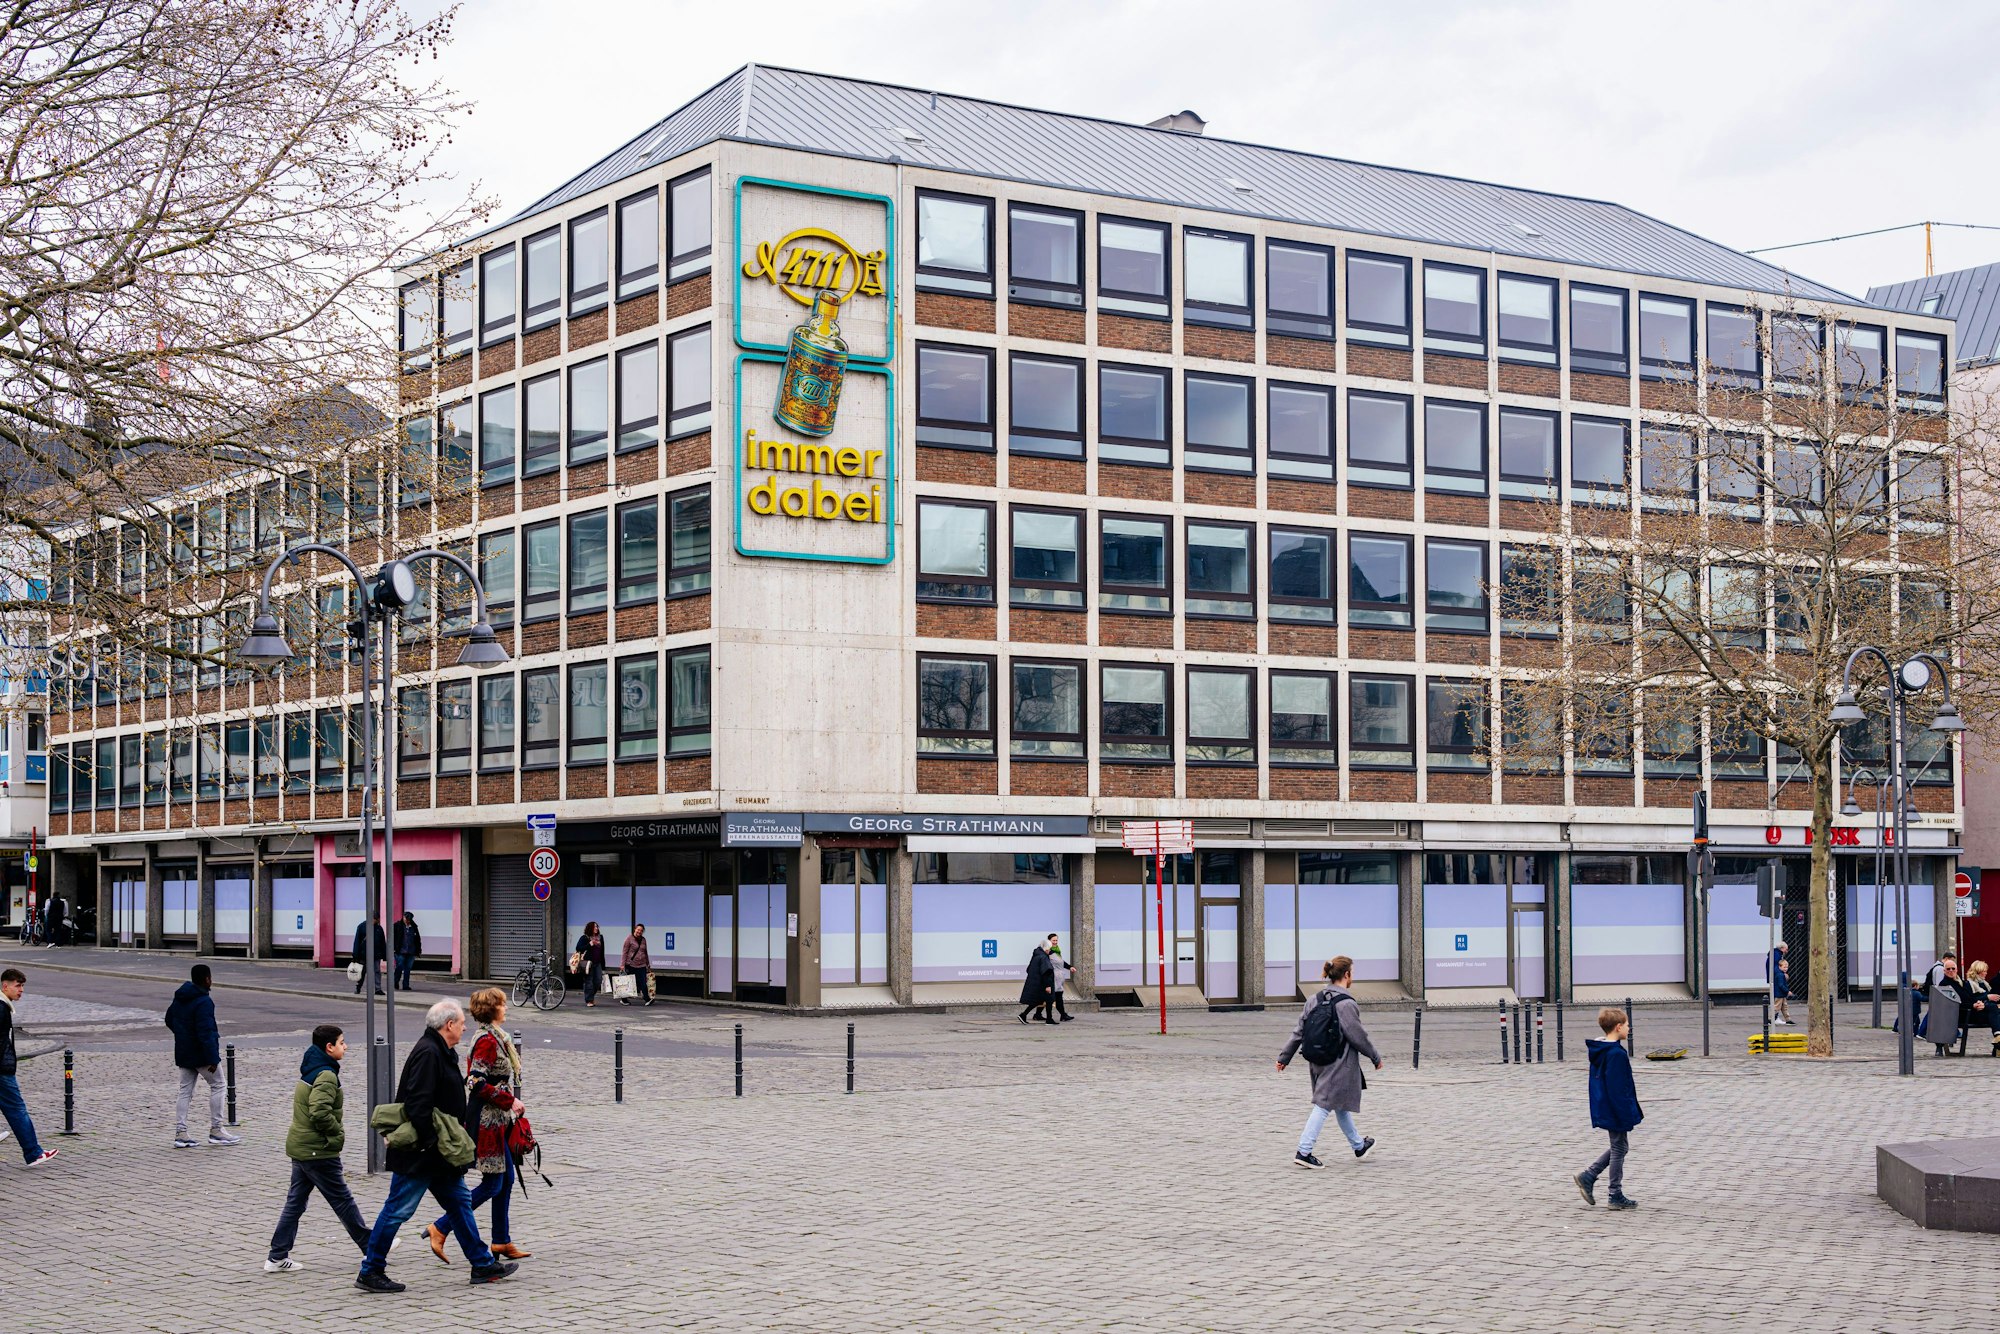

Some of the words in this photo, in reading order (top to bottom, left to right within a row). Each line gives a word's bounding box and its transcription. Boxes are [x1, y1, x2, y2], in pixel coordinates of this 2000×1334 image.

[781, 248, 849, 289] 4711
[747, 428, 883, 478] immer
[748, 475, 881, 523] dabei
[611, 825, 644, 838] GEORG
[648, 823, 719, 836] STRATHMANN
[728, 824, 801, 832] STRATHMANN
[849, 816, 913, 831] GEORG
[922, 818, 1044, 833] STRATHMANN
[1804, 827, 1860, 845] OSK
[536, 856, 553, 870] 30
[1828, 869, 1836, 922] KIOSK
